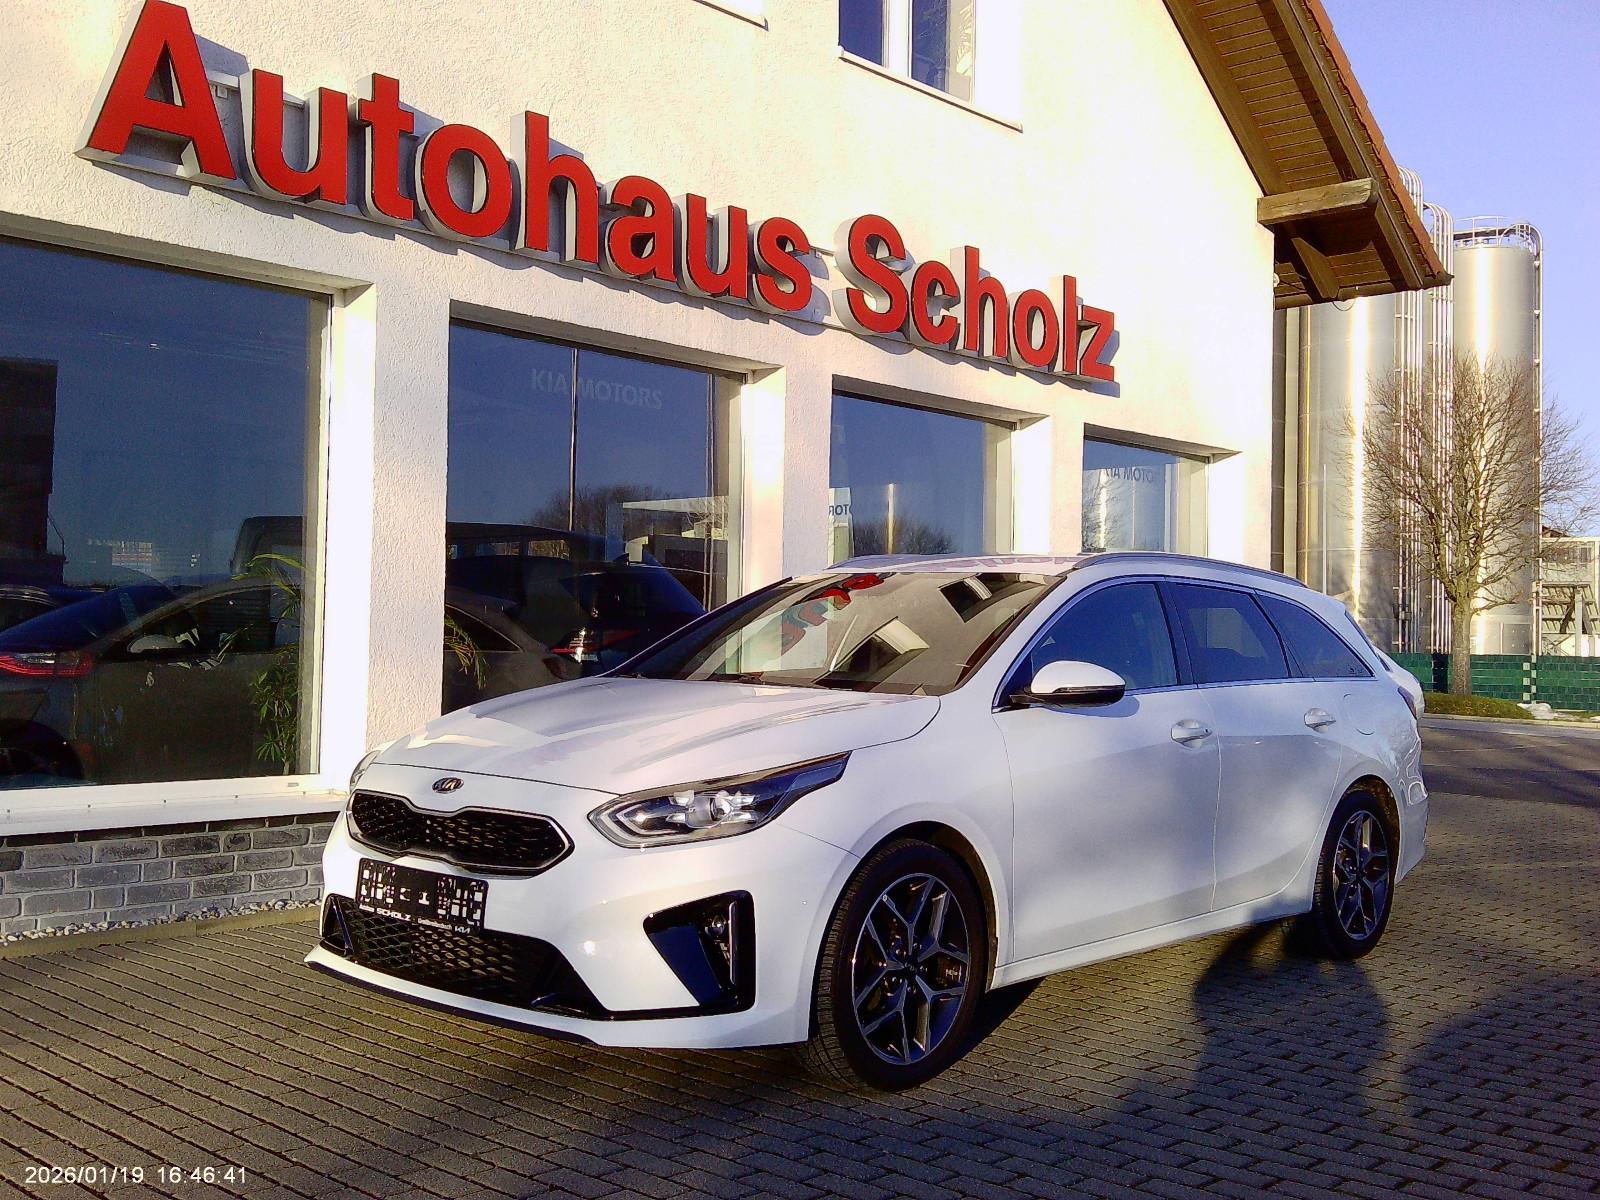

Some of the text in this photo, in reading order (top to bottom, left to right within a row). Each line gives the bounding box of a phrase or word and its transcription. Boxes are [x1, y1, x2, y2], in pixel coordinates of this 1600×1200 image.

[76, 0, 1115, 382] Autohaus Scholz
[530, 368, 663, 411] KIA MOTORS
